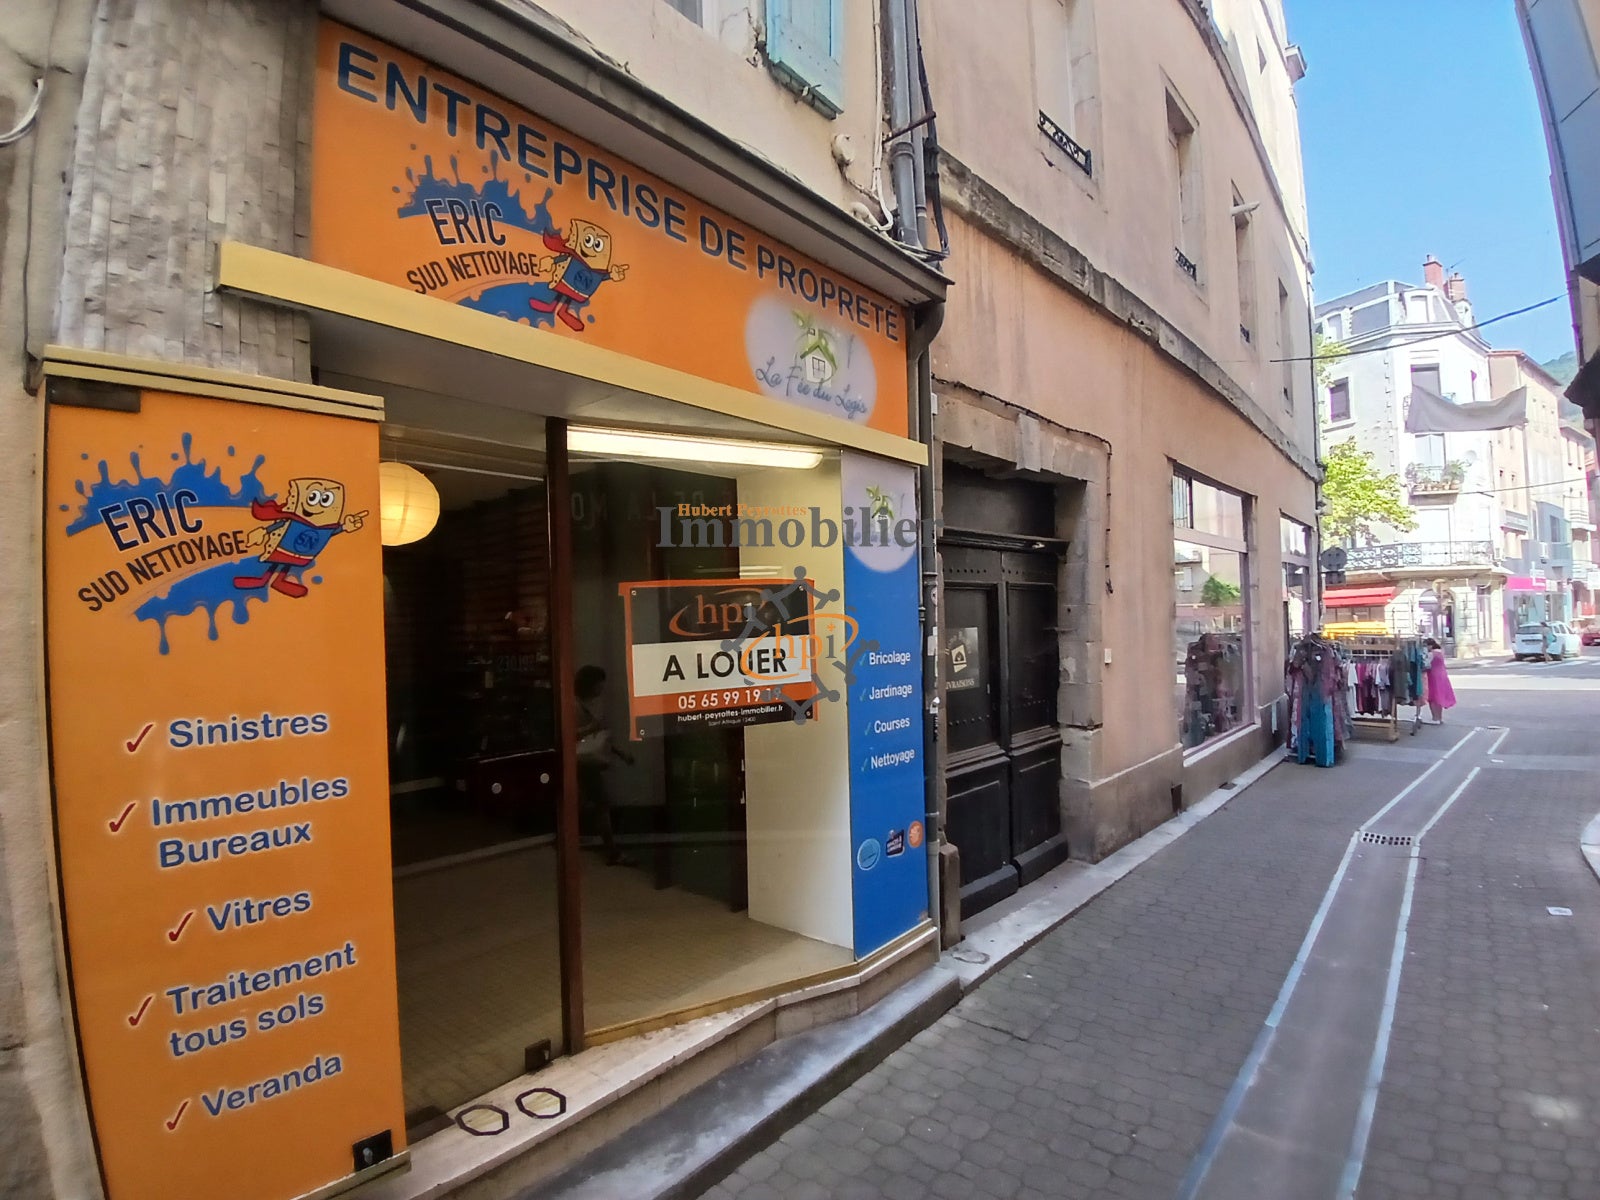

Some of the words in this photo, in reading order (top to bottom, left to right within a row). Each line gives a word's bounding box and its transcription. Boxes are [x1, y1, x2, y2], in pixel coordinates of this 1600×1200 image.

[337, 42, 688, 243] ENTREPRISE
[700, 215, 747, 271] DE
[757, 244, 899, 342] PROPRETÉ
[424, 198, 506, 247] ERIC
[406, 261, 449, 295] SUD
[446, 250, 540, 283] NETTOYAGE
[99, 488, 203, 552] ERIC
[78, 570, 130, 612] SUD
[126, 530, 249, 586] NETTOYAGE
[662, 654, 686, 682] A
[697, 648, 787, 680] LOUER
[869, 650, 911, 667] Bricolage
[678, 695, 696, 710] 05
[701, 692, 719, 707] 65
[723, 690, 740, 705] 99
[745, 689, 761, 703] 19
[869, 682, 913, 700] Jardinage
[168, 712, 329, 748] Sinistres
[874, 717, 910, 734] Courses
[870, 747, 915, 770] Nettoyage
[152, 776, 349, 827] Immeubles
[159, 821, 311, 868] Bureaux
[207, 891, 311, 931] Vitres
[166, 942, 356, 1015] Traitement
[169, 1017, 247, 1057] tous
[257, 993, 325, 1031] sols
[201, 1054, 343, 1117] Veranda
